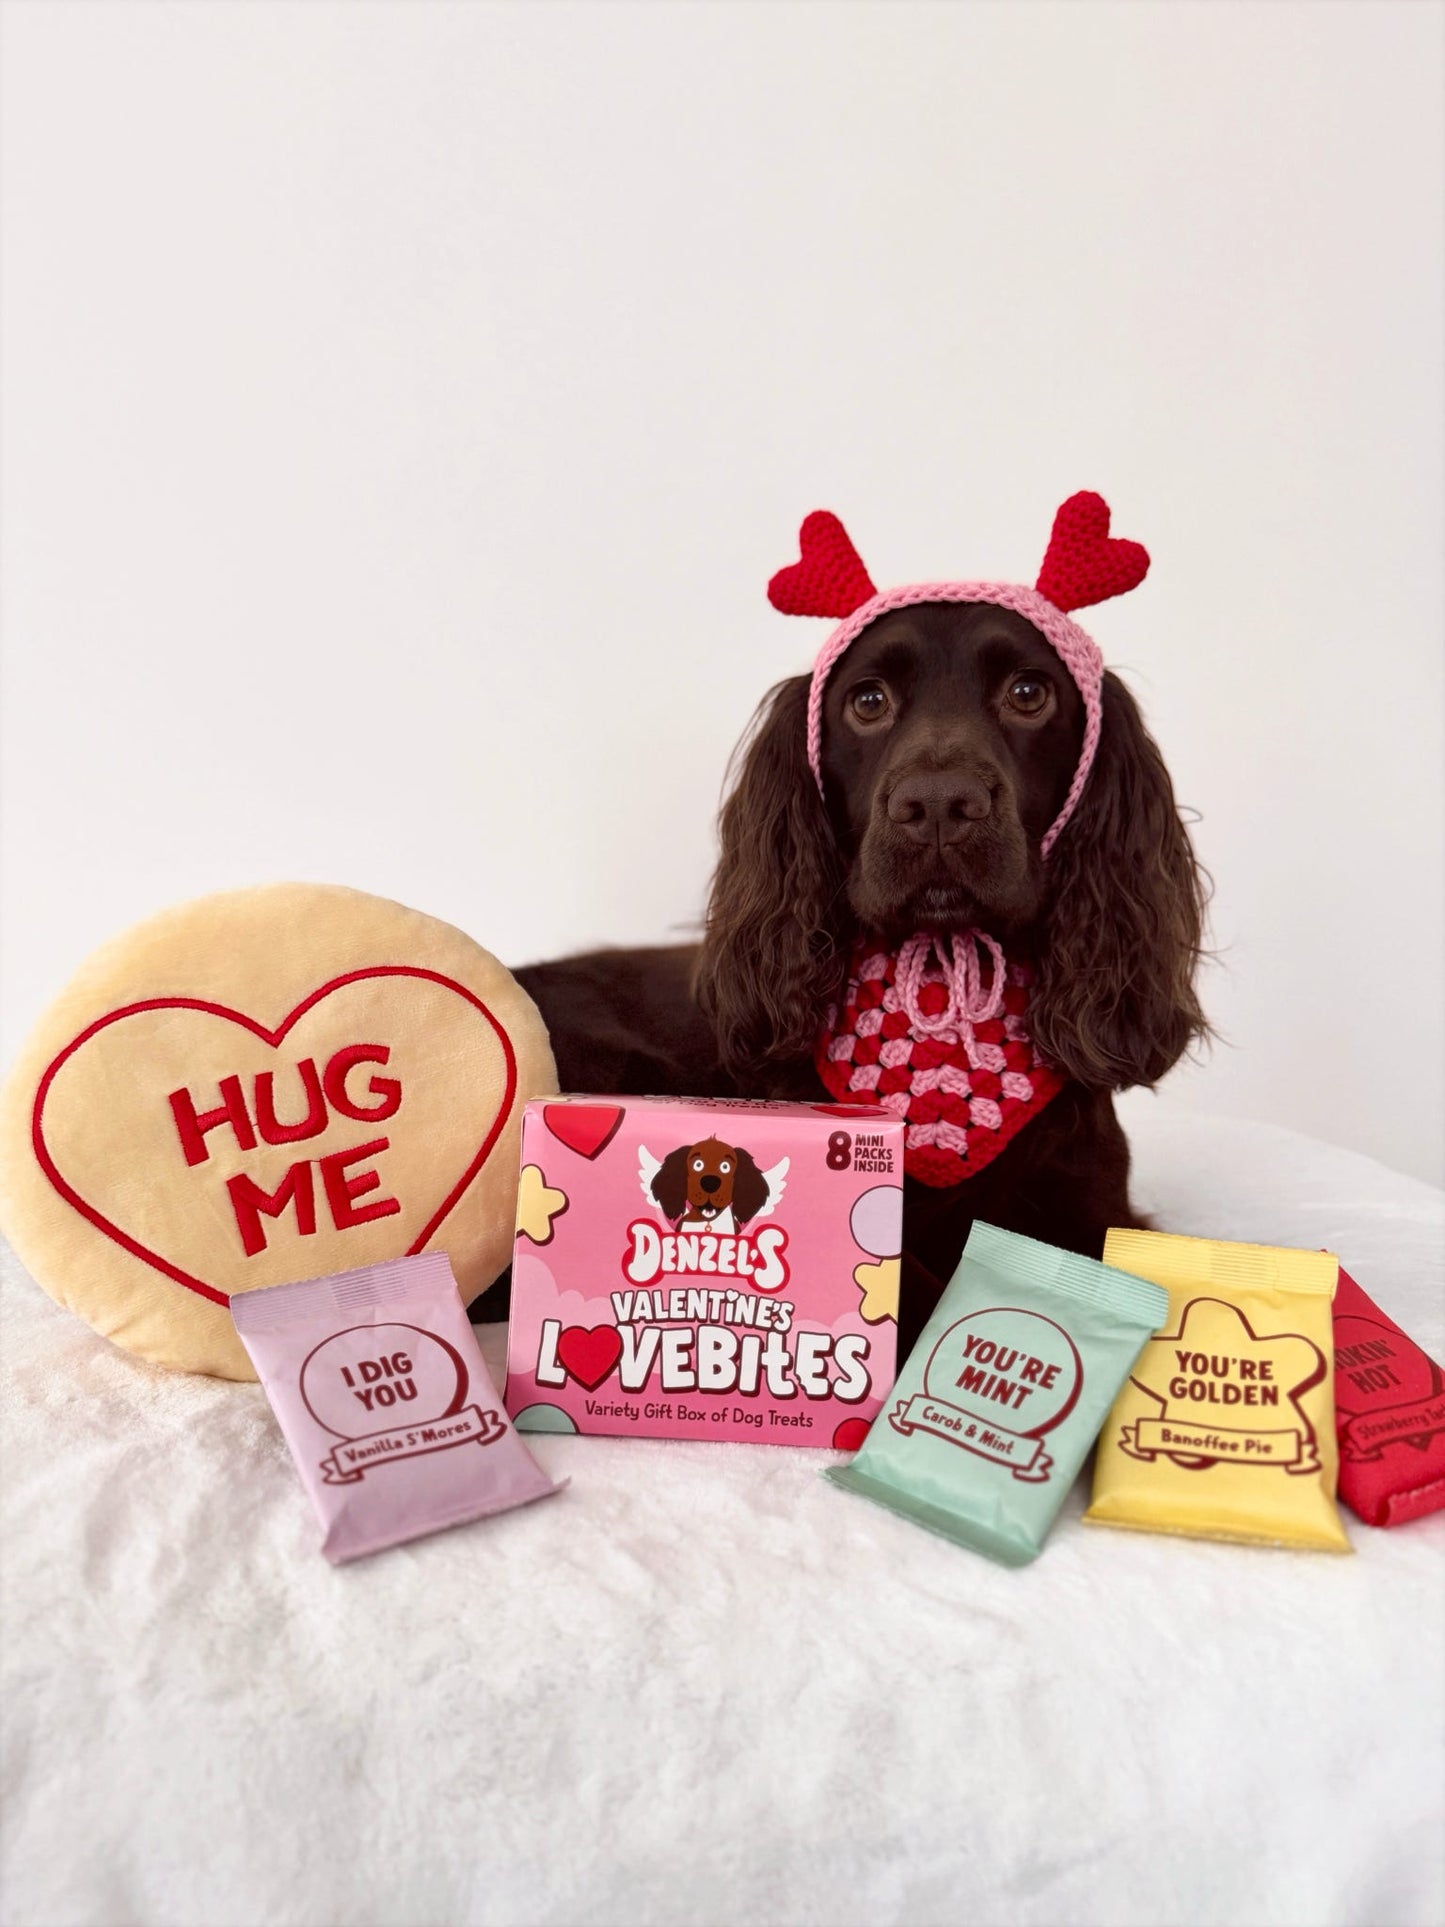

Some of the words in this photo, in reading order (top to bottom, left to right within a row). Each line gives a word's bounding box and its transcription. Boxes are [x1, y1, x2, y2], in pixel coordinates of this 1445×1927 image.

[168, 1044, 402, 1167] HUG
[826, 1130, 852, 1171] 8
[854, 1147, 893, 1160] PACKS
[855, 1134, 884, 1147] MINI
[854, 1160, 894, 1173] INSIDE
[225, 1137, 401, 1257] ME
[627, 1223, 785, 1289] DENZEL'S
[340, 1366, 355, 1388] I
[357, 1351, 414, 1384] DIG
[960, 1334, 1062, 1390] YOU'RE
[1175, 1350, 1273, 1381] YOU'RE
[1334, 1339, 1397, 1371] OKIN'
[353, 1378, 418, 1411] YOU
[955, 1366, 1034, 1410] MINT
[1169, 1377, 1279, 1406] GOLDEN
[1347, 1364, 1402, 1394] HOT
[585, 1400, 639, 1421] Variety
[644, 1403, 673, 1420] Gift
[677, 1405, 706, 1421] Box
[711, 1407, 729, 1423] of
[732, 1408, 763, 1428] Dog
[768, 1410, 813, 1428] Treats
[922, 1405, 963, 1431] Carob
[964, 1424, 977, 1438] &
[979, 1430, 1014, 1454] Mint
[1356, 1415, 1430, 1440] Strawberry
[344, 1438, 403, 1462] Vanilla
[406, 1421, 472, 1446] S'Mores
[1161, 1428, 1239, 1453] Banoffee
[1244, 1439, 1273, 1455] Pie
